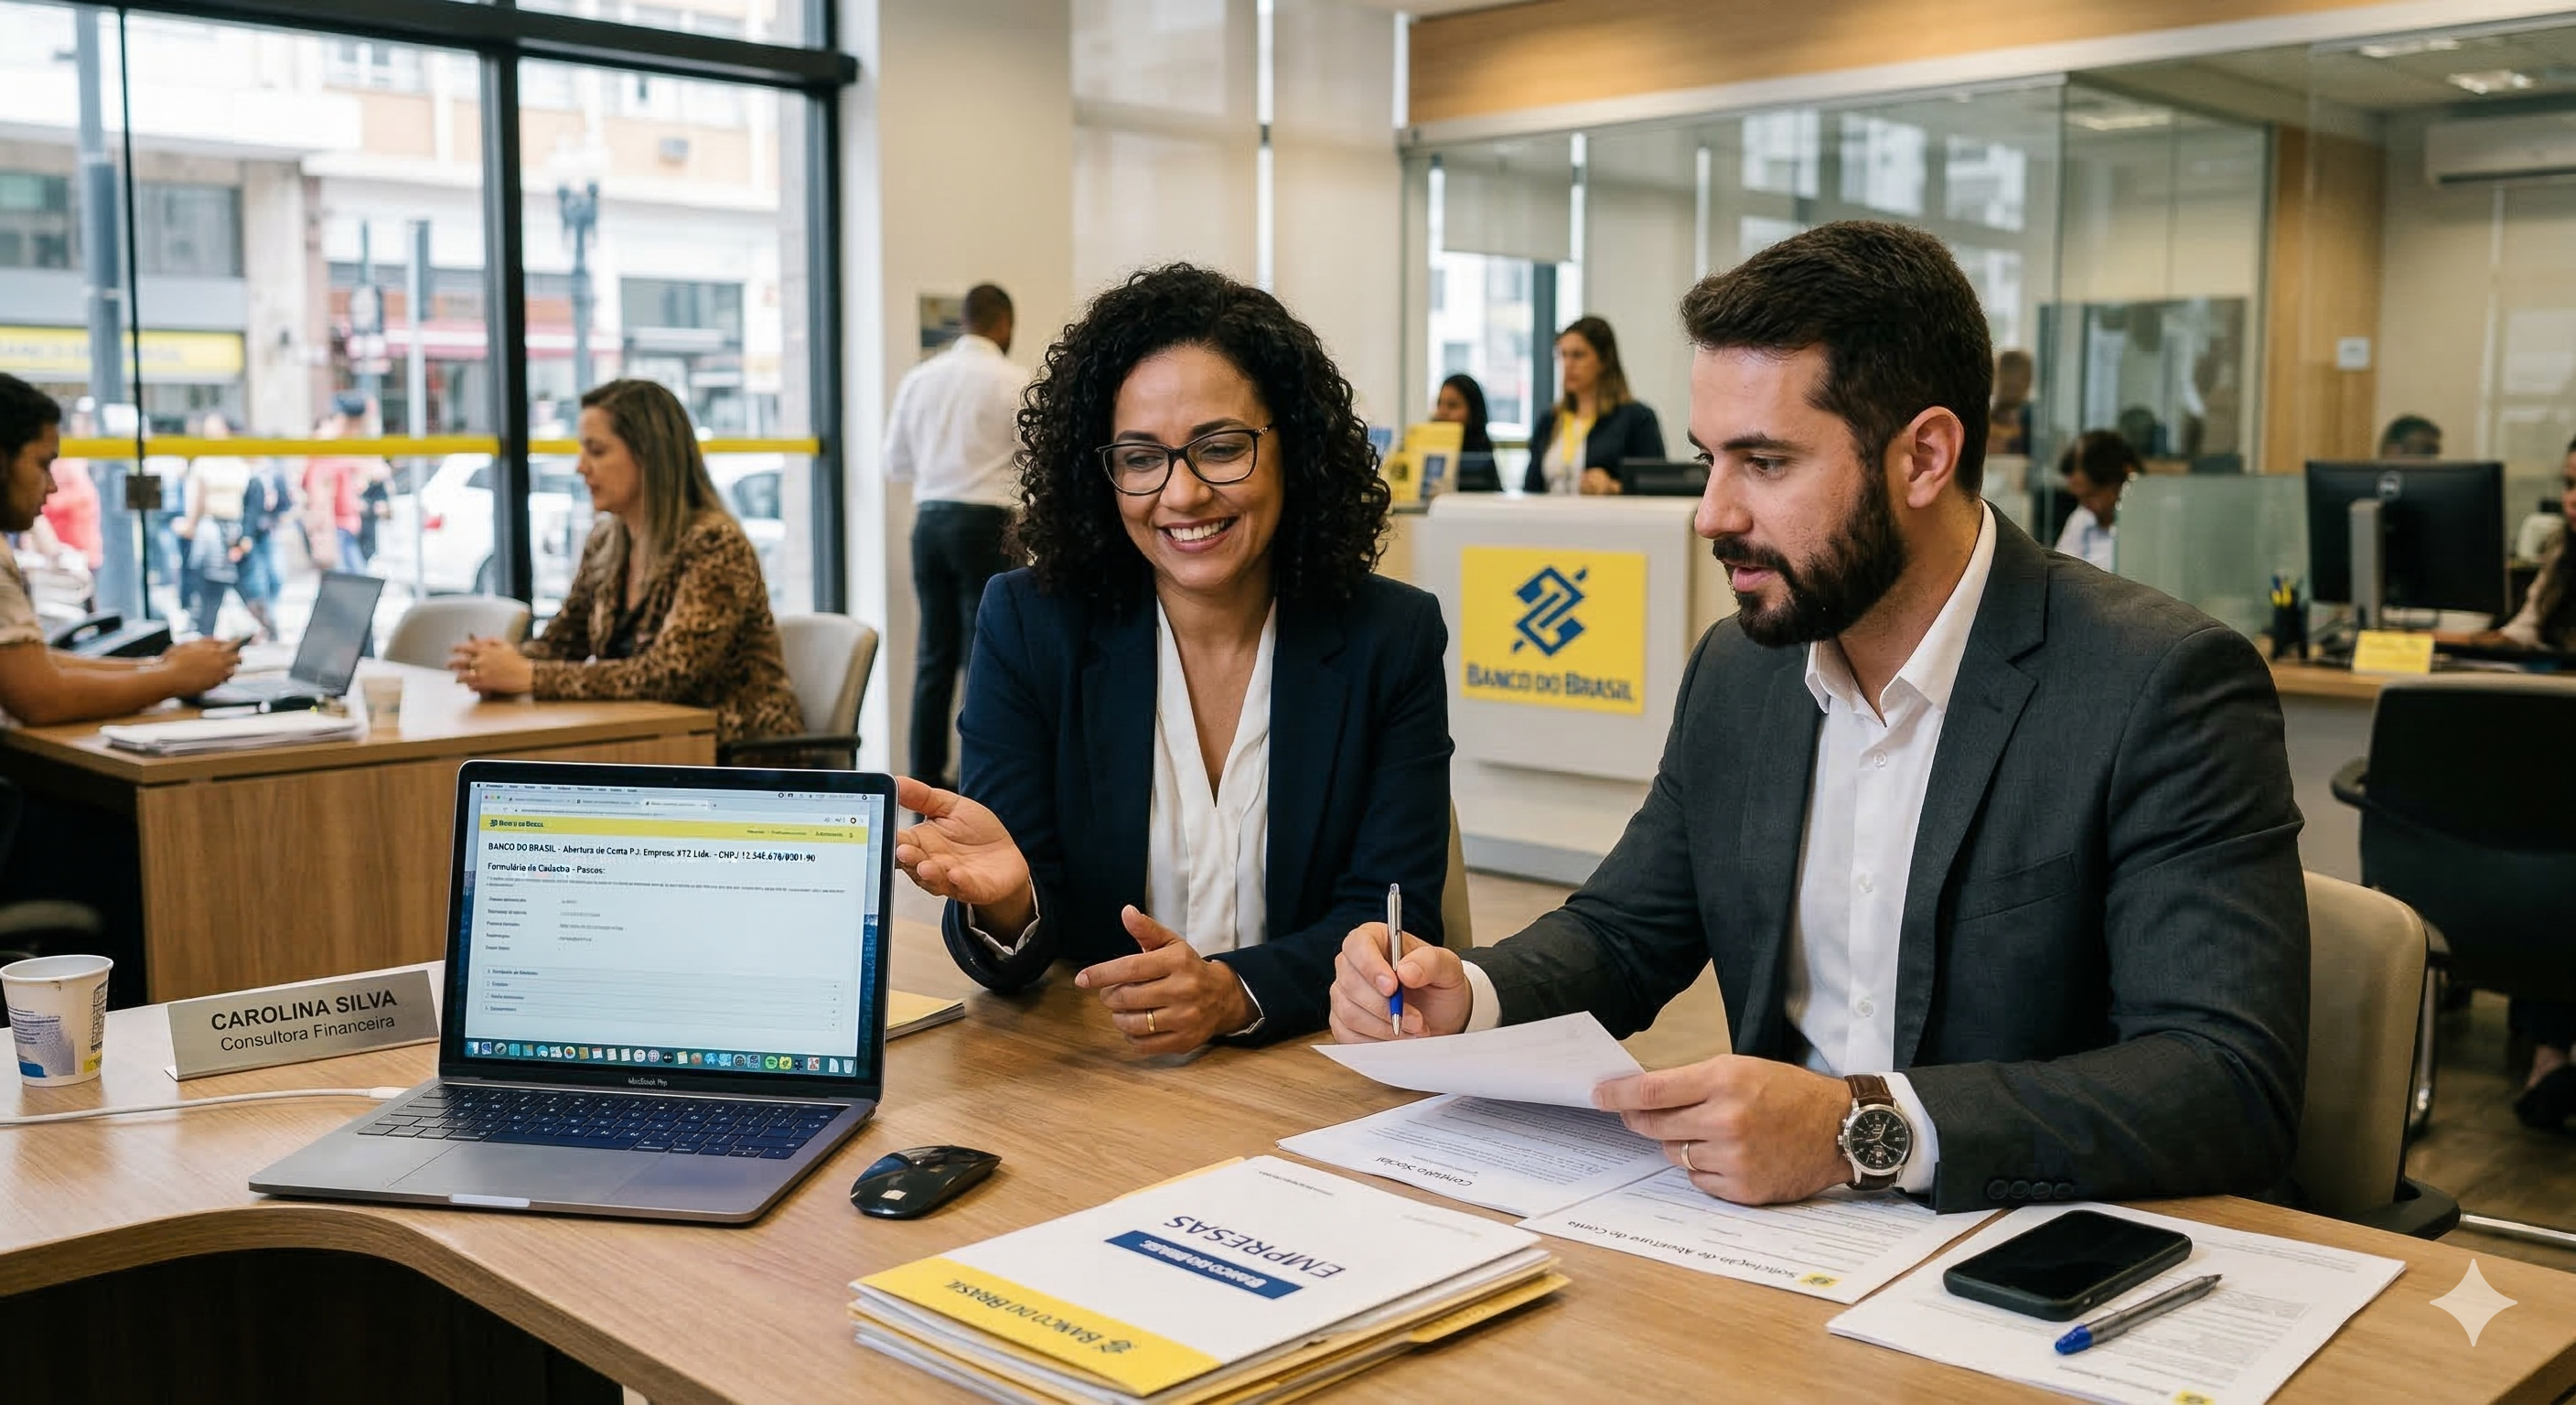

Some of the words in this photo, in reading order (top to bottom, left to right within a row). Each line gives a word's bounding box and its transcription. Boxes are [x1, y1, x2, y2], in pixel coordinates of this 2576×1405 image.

[488, 842, 515, 851] BANCO
[516, 843, 528, 852] DO
[529, 844, 556, 853] BRASIL
[718, 851, 739, 860] CNPJ
[211, 1000, 330, 1031] CAROLINA
[336, 990, 397, 1014] SILVA
[220, 1030, 308, 1051] Consultora
[313, 1015, 395, 1039] Financeira
[1163, 1216, 1346, 1278] EMPRESAS
[945, 1279, 1010, 1309] BRASIL
[1004, 1303, 1039, 1317] DO
[1031, 1314, 1103, 1344] BANCO
